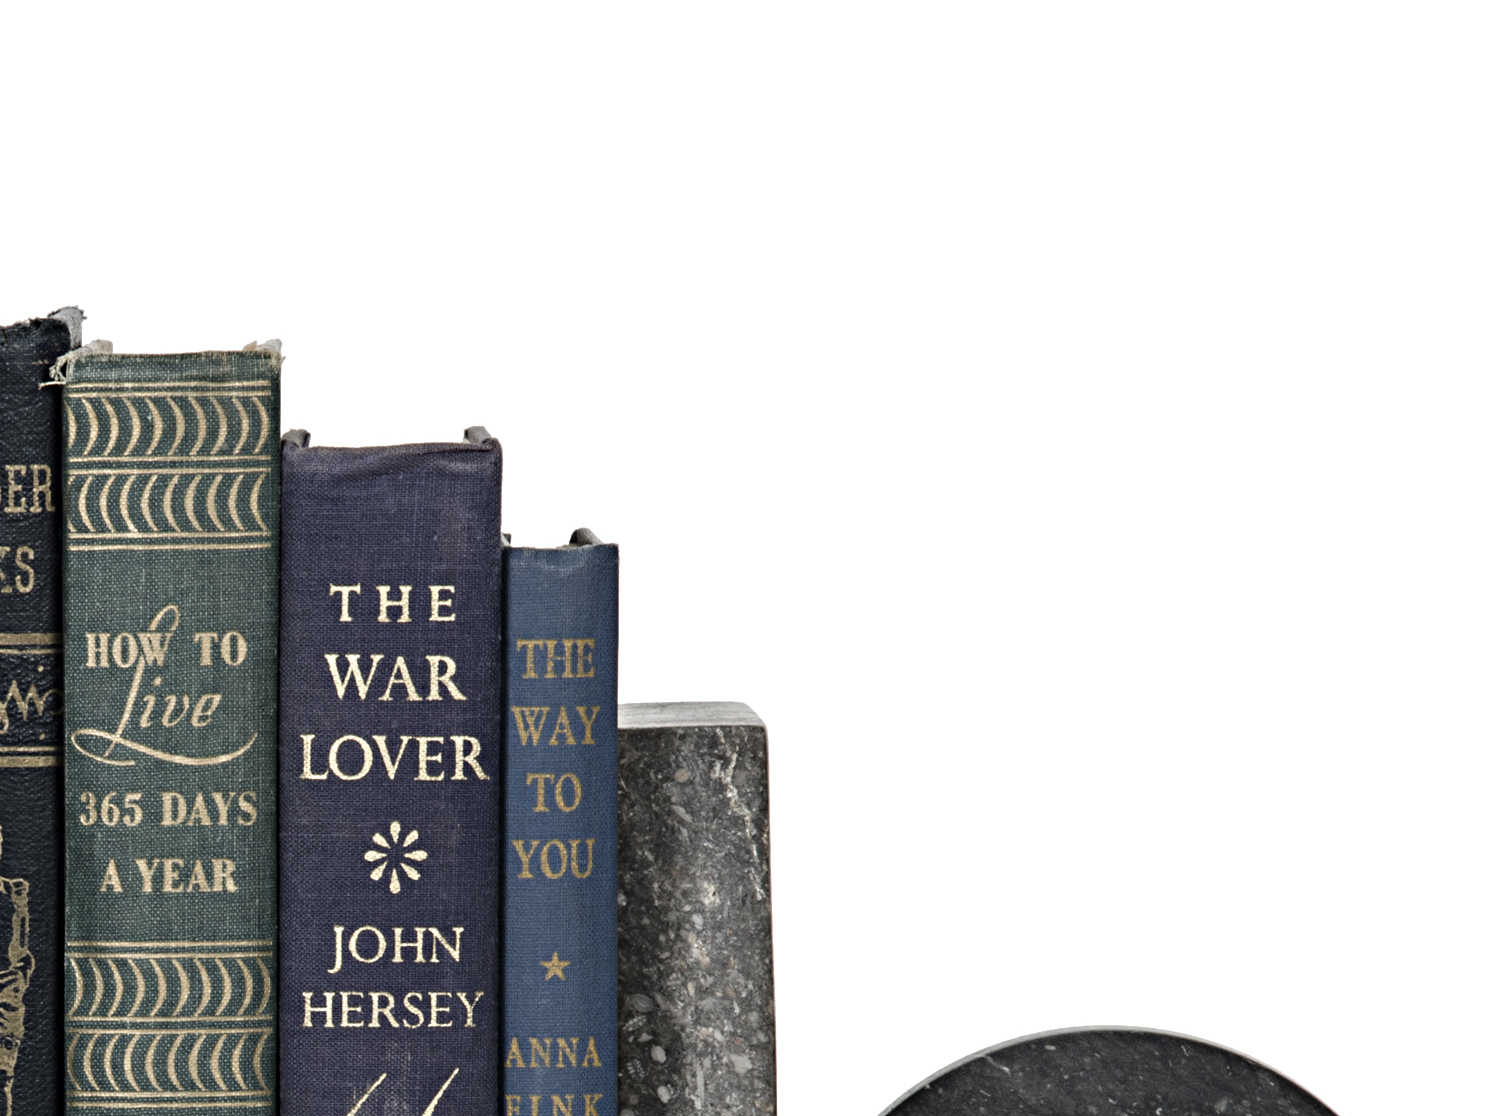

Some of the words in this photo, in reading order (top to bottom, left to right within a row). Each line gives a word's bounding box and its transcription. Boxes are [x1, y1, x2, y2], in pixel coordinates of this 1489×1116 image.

[329, 583, 457, 622] THE
[85, 631, 174, 668] HOW
[195, 631, 248, 667] TO
[516, 638, 596, 680] THE
[71, 604, 258, 765] Live
[324, 653, 466, 702] WAR
[511, 705, 601, 747] WAY
[299, 733, 490, 782] LOVER
[79, 792, 144, 827] 365
[161, 791, 257, 827] DAYS
[525, 772, 583, 813] TO
[100, 858, 124, 893] A
[133, 857, 238, 894] YEAR
[512, 838, 596, 880] YOU
[327, 925, 464, 974] JOHN
[301, 990, 484, 1029] HERSEY
[504, 1036, 602, 1068] ANNA
